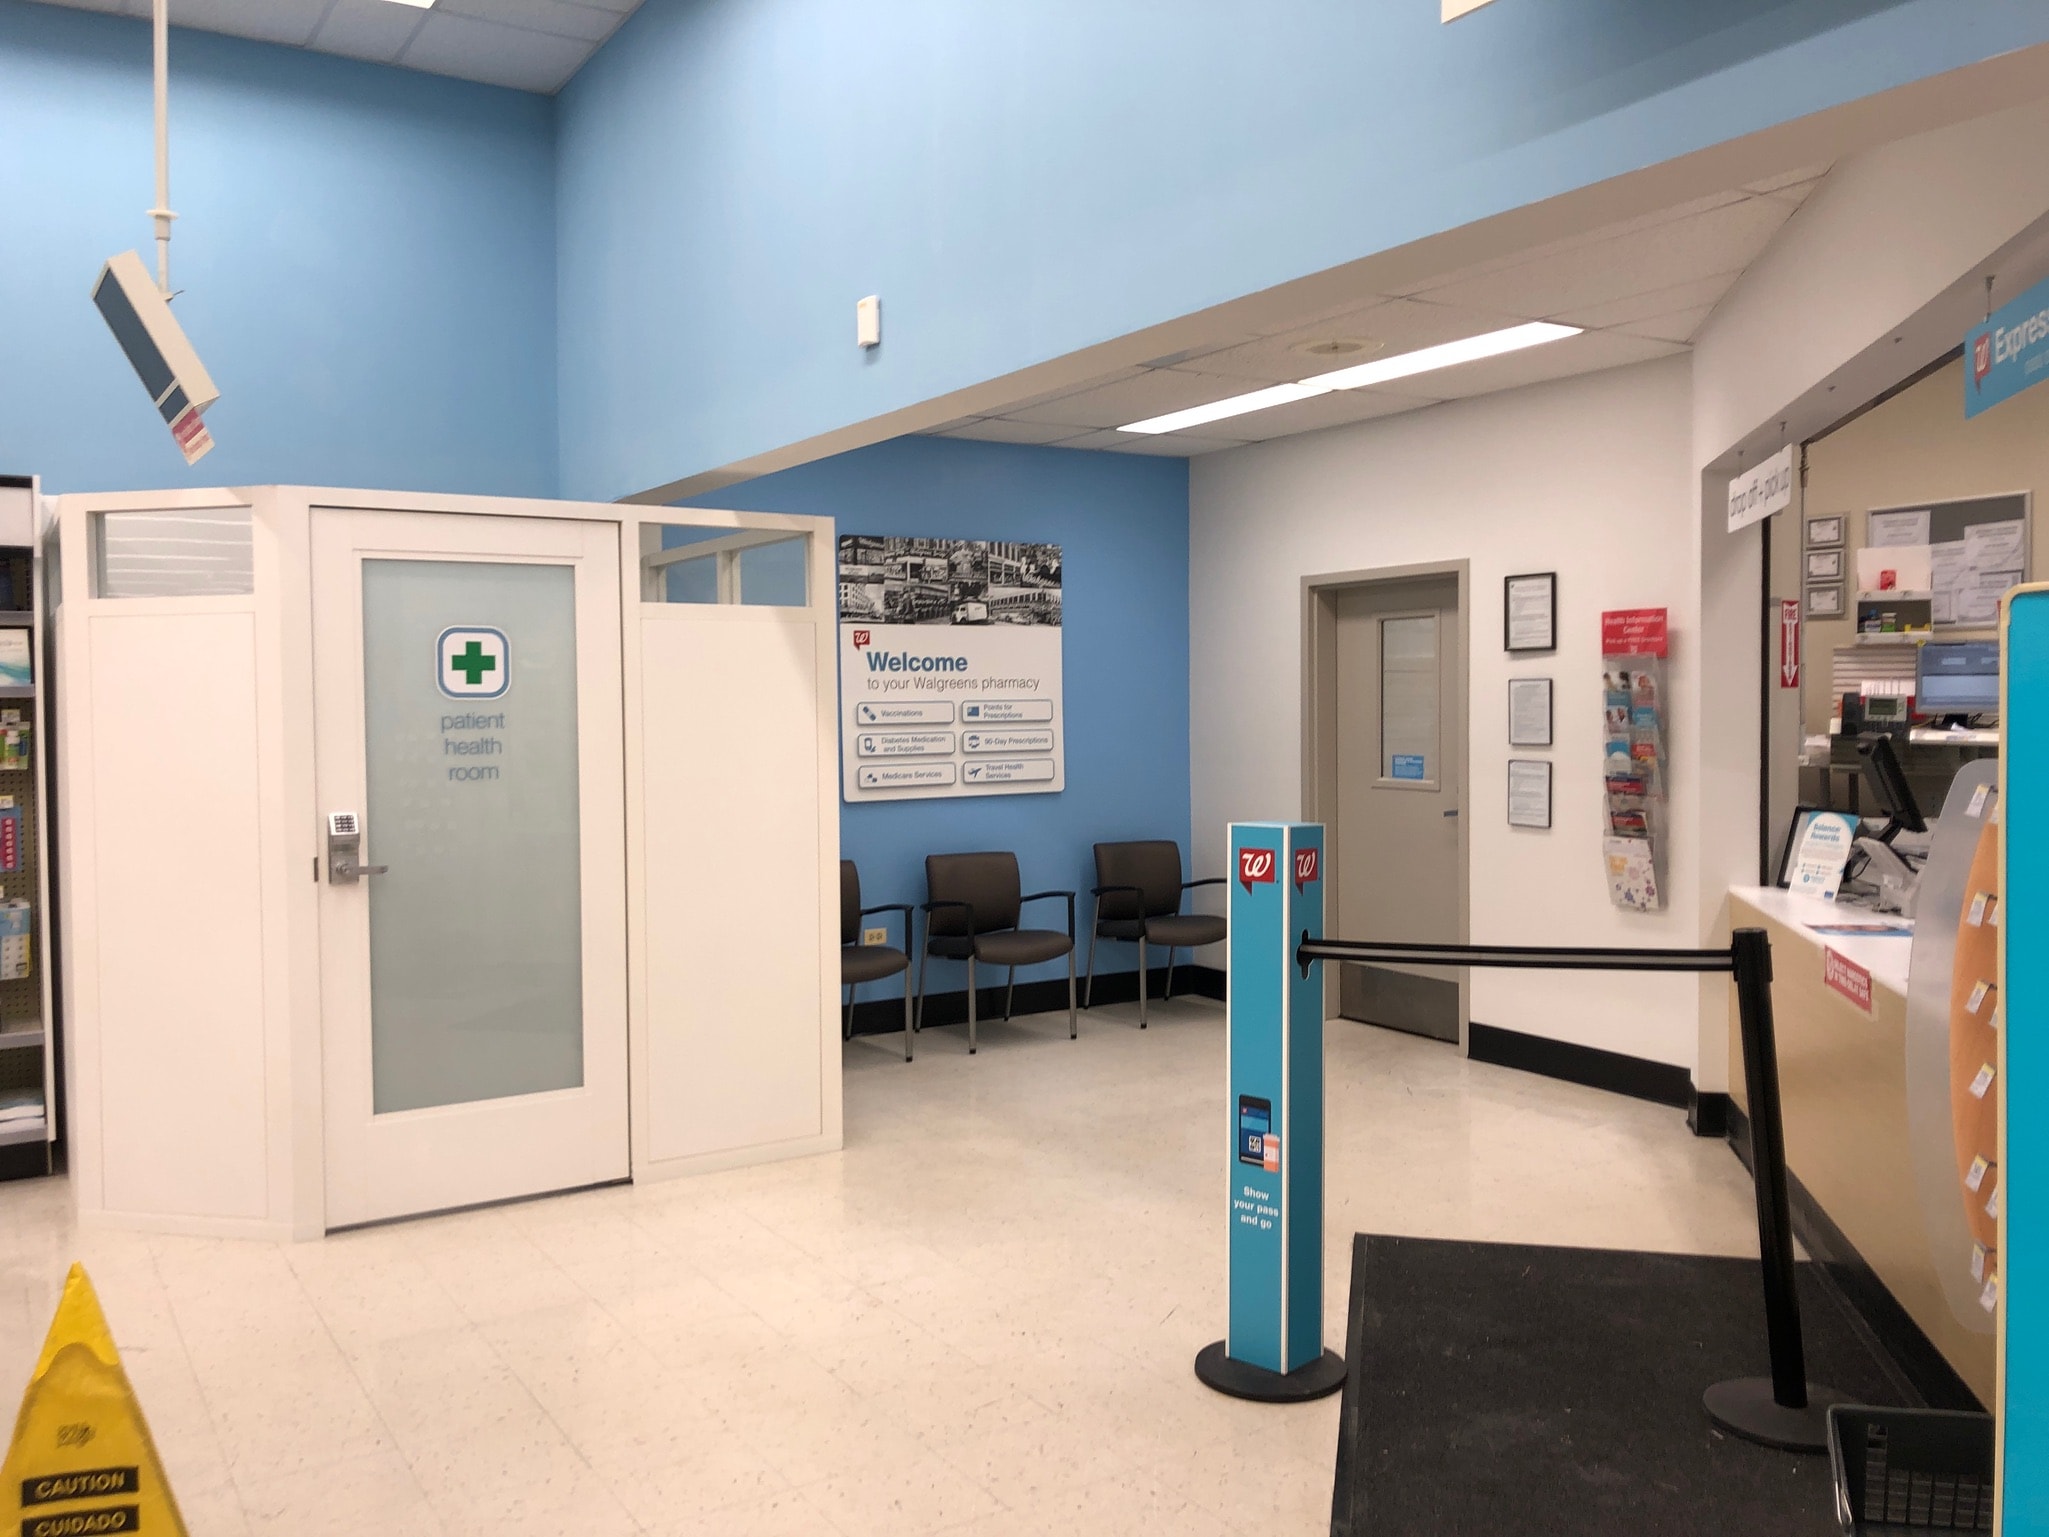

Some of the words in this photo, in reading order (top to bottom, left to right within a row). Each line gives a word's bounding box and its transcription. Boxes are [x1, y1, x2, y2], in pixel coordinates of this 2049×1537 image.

[1606, 617, 1625, 625] Health
[1626, 615, 1664, 624] Information
[1623, 626, 1645, 634] Center
[866, 651, 968, 672] Welcome
[867, 677, 879, 690] to
[883, 679, 910, 692] your
[914, 677, 978, 692] Walgreens
[981, 676, 1040, 692] pharmacy
[440, 712, 505, 734] patient
[444, 737, 502, 755] health
[897, 745, 925, 753] Supplies
[985, 738, 1007, 746] 90-Day
[1008, 736, 1049, 744] Prescriptions
[448, 764, 499, 781] room
[882, 772, 913, 780] Medicare
[1242, 852, 1271, 877] W
[1243, 1186, 1270, 1201] Show
[1234, 1199, 1255, 1211] your
[1257, 1203, 1279, 1217] pass
[1240, 1213, 1258, 1225] and
[1260, 1219, 1272, 1230] go
[35, 1471, 126, 1499] CAUTION
[35, 1510, 127, 1537] CUIDADO
